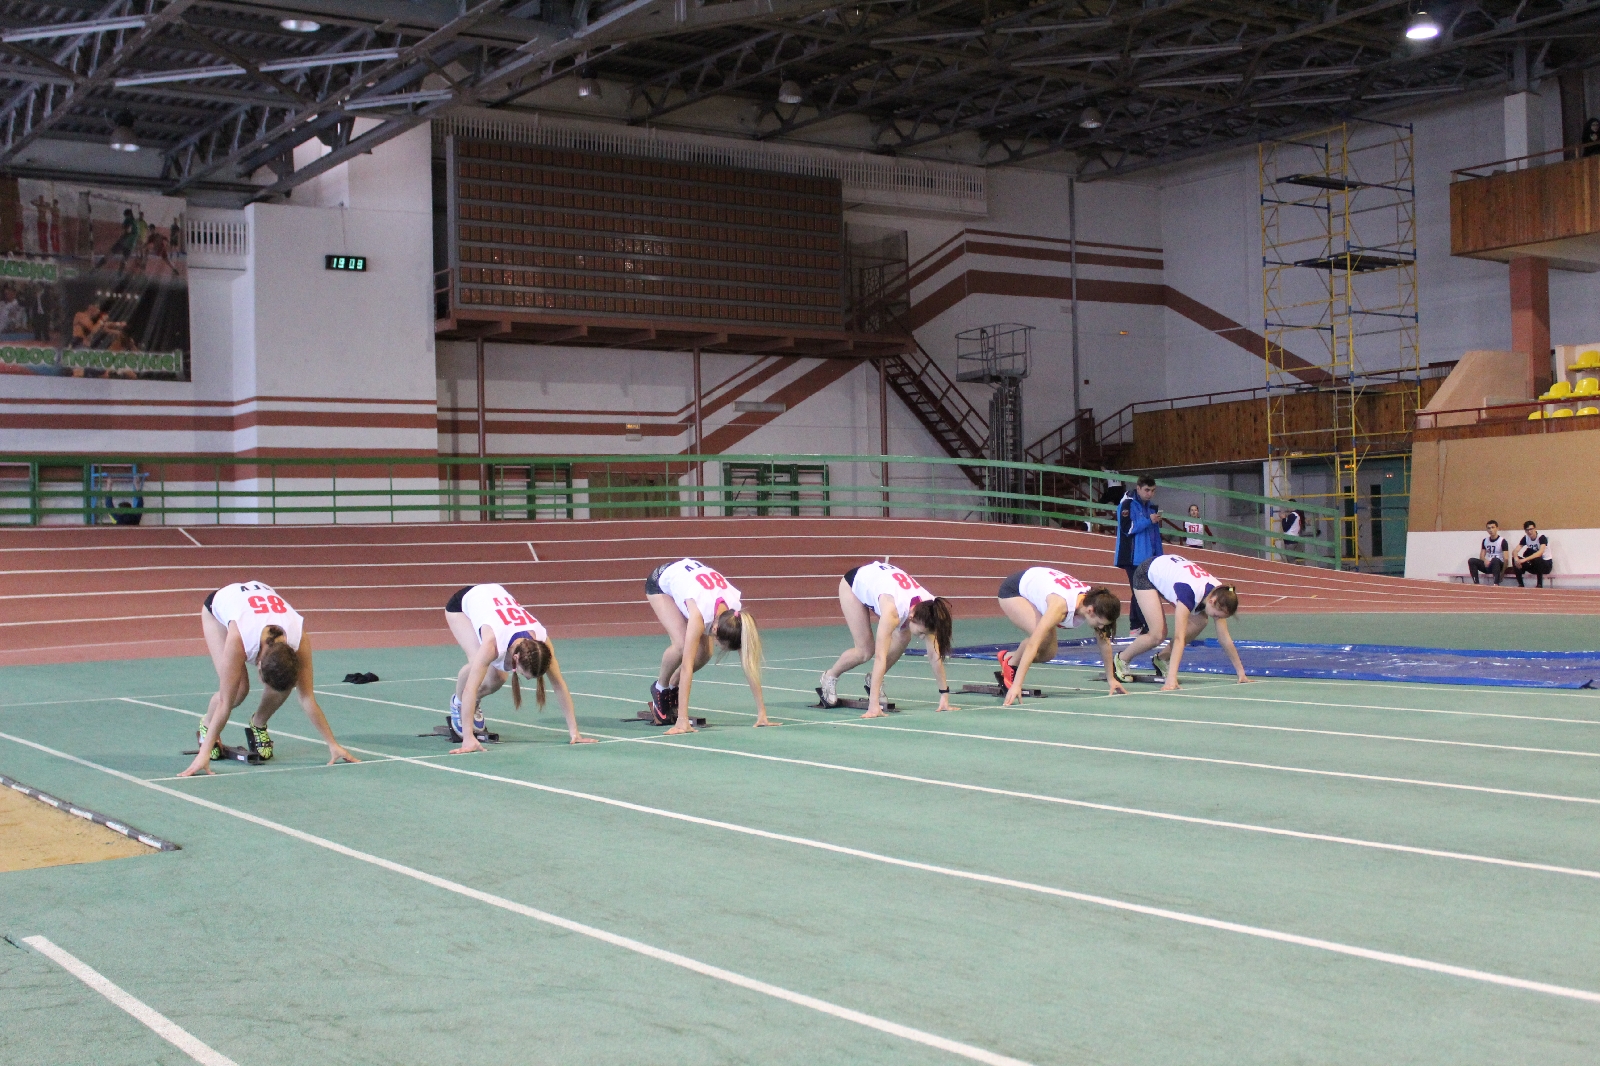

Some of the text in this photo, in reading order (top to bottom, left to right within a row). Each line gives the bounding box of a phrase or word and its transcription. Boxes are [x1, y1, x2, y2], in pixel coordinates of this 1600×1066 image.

[0, 346, 57, 365] овое
[695, 572, 728, 590] 80
[247, 595, 287, 614] 85
[495, 607, 538, 627] 151
